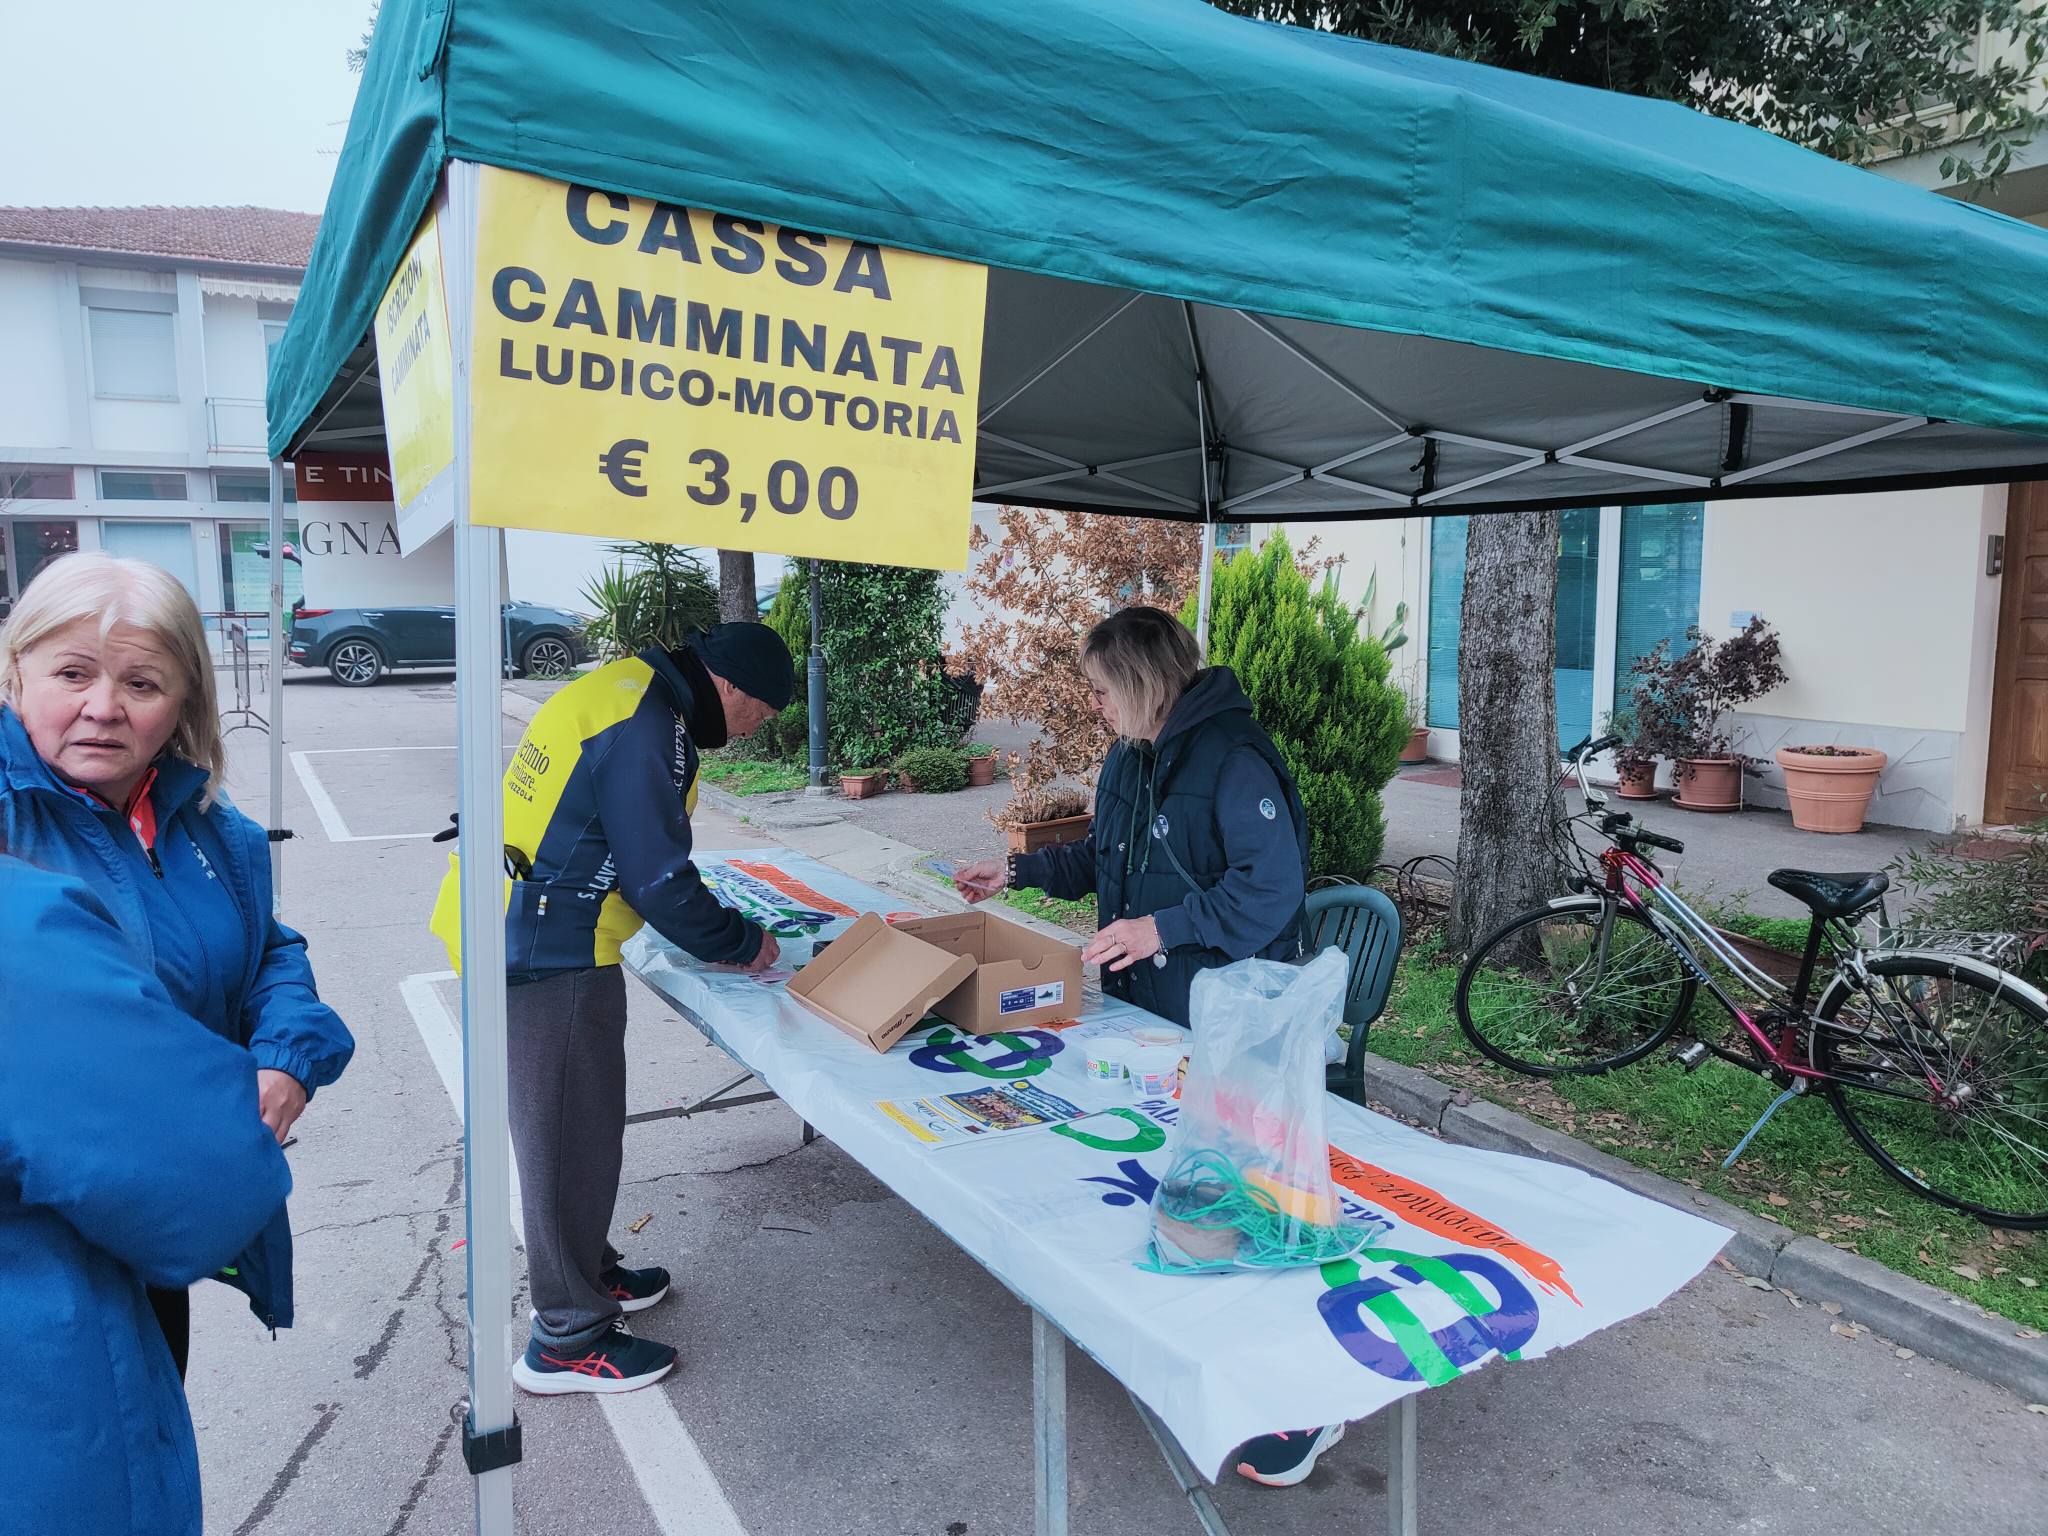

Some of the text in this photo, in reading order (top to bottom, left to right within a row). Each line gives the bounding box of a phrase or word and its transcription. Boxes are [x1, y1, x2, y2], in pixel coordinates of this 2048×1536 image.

[566, 184, 892, 301] CASSA
[491, 266, 965, 395] CAMMINATA
[499, 338, 963, 444] LUDICO-MOTORIA
[305, 466, 325, 483] E
[598, 438, 859, 524] € 3,00
